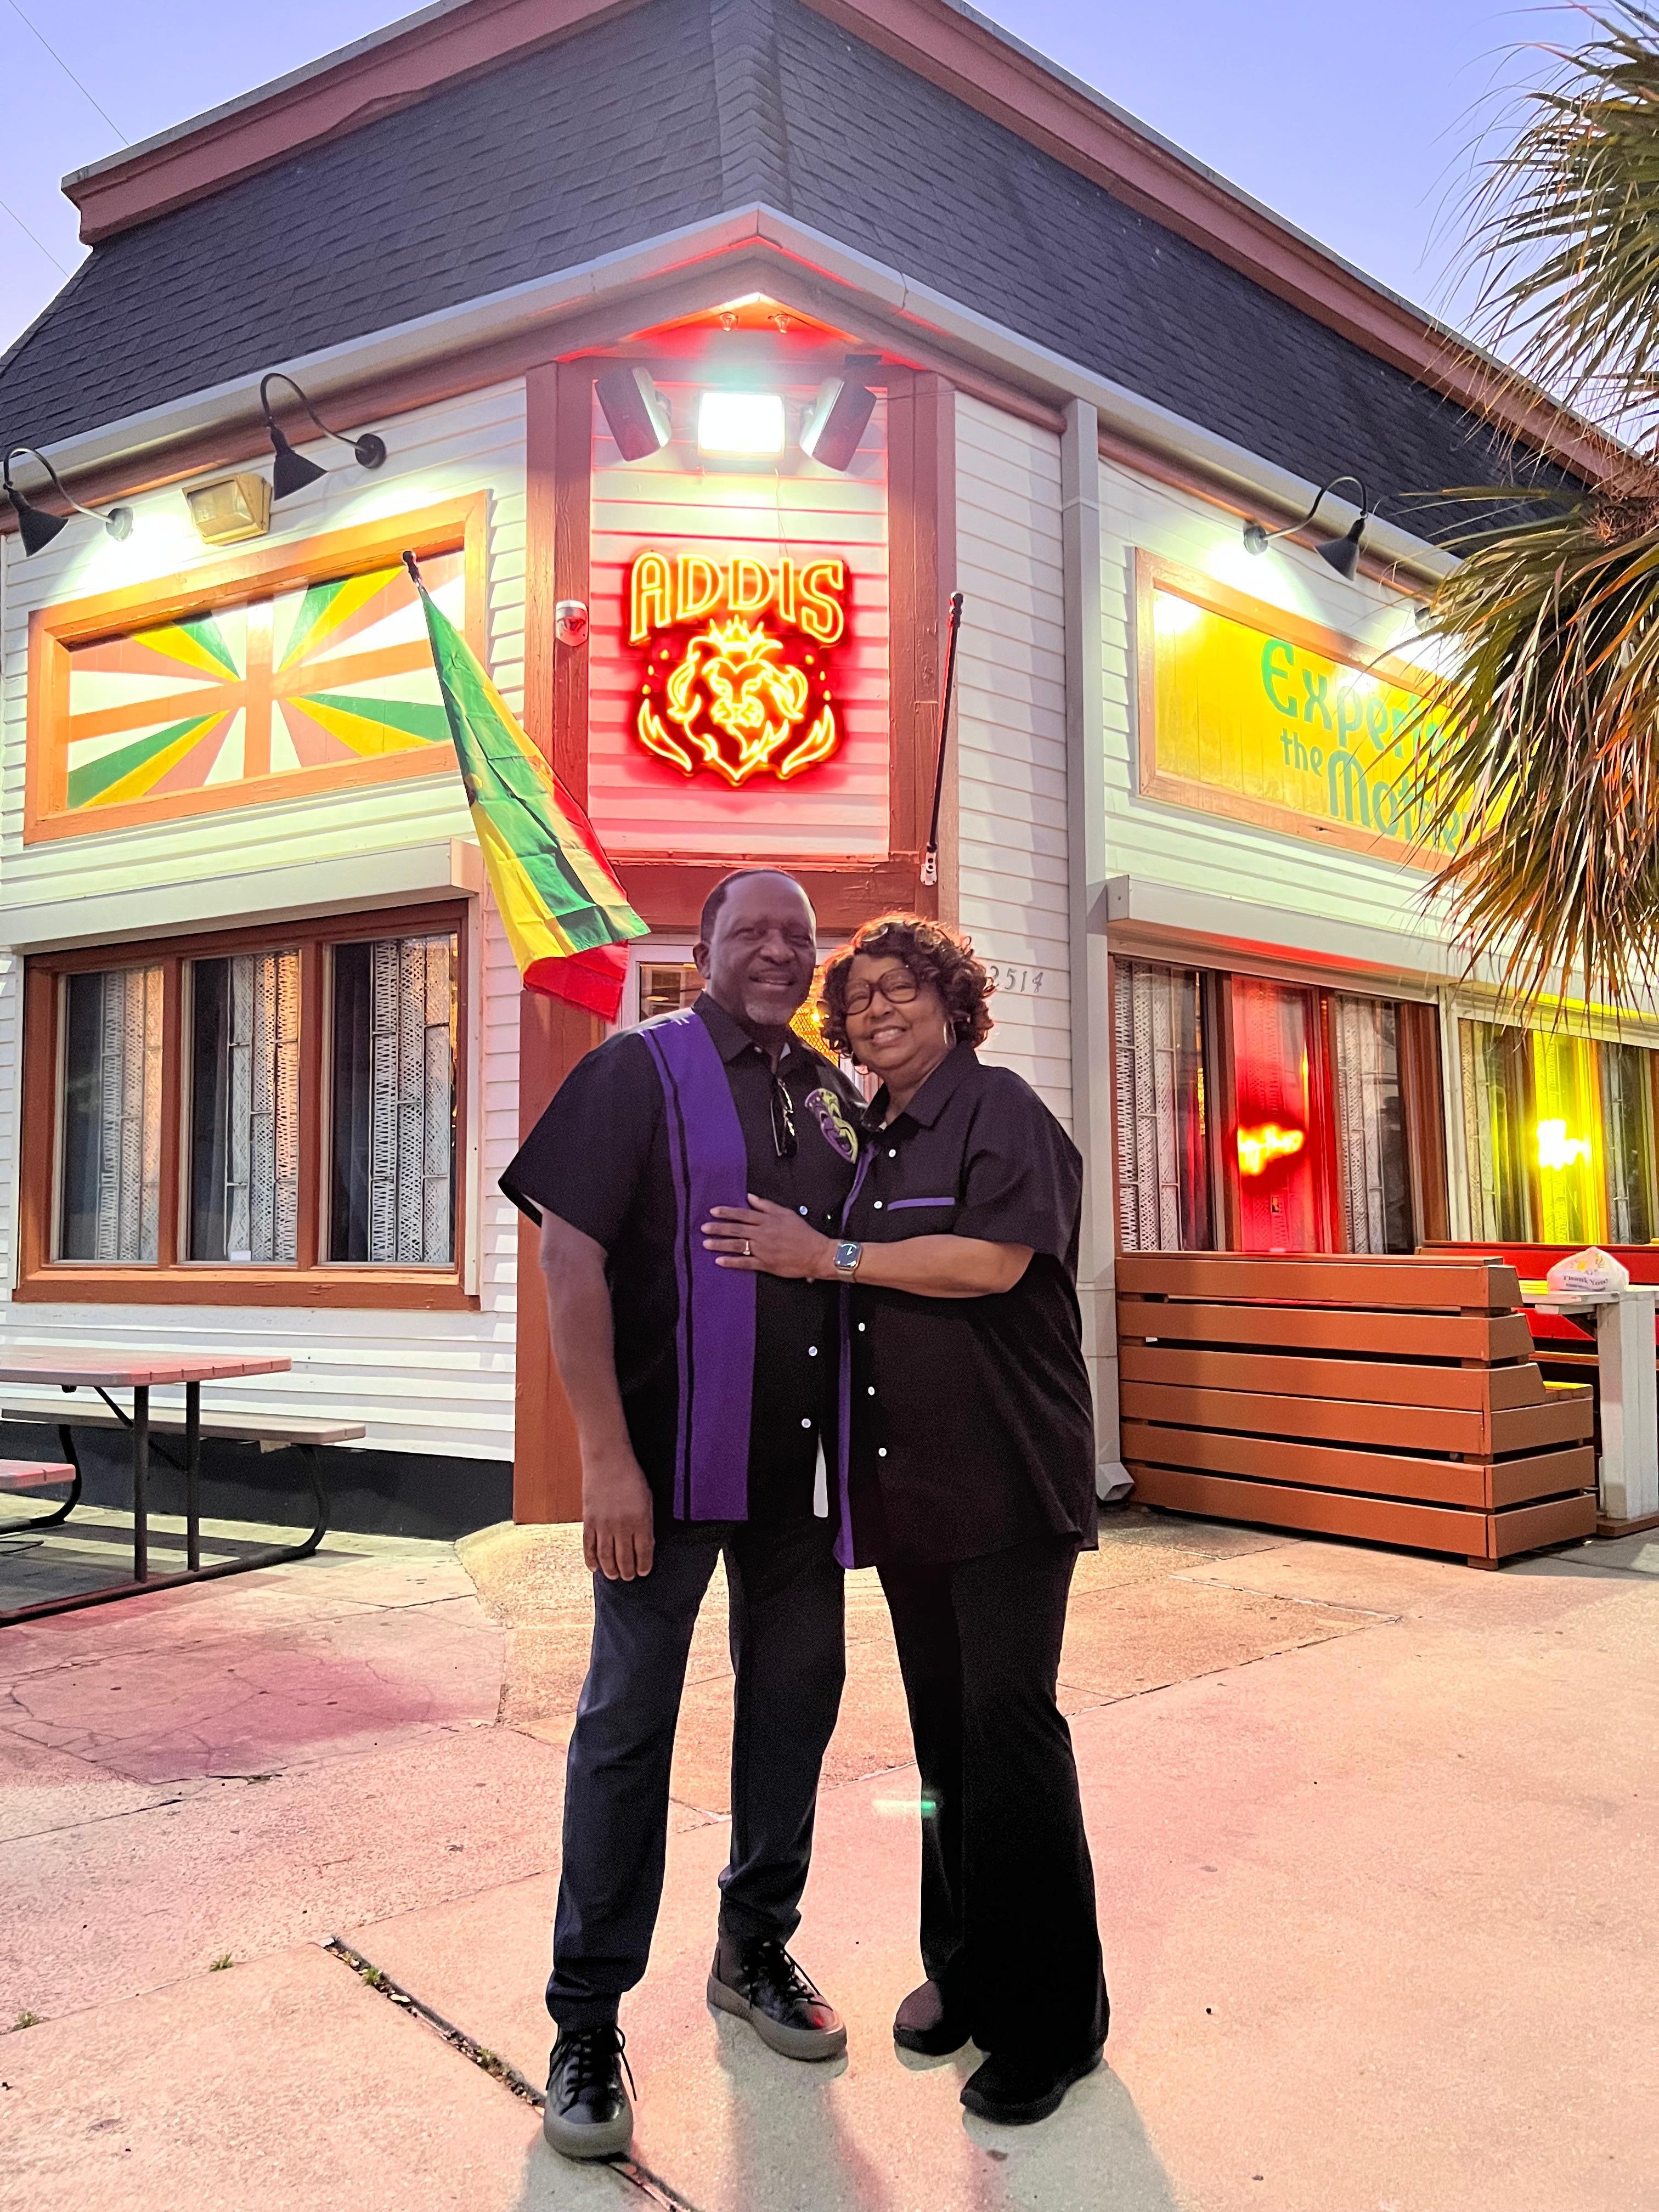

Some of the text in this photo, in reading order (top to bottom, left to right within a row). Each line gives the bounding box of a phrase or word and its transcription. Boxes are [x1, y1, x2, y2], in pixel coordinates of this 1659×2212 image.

[630, 551, 844, 644] ADDIS
[1280, 727, 1323, 777] the
[990, 966, 1043, 993] 2514
